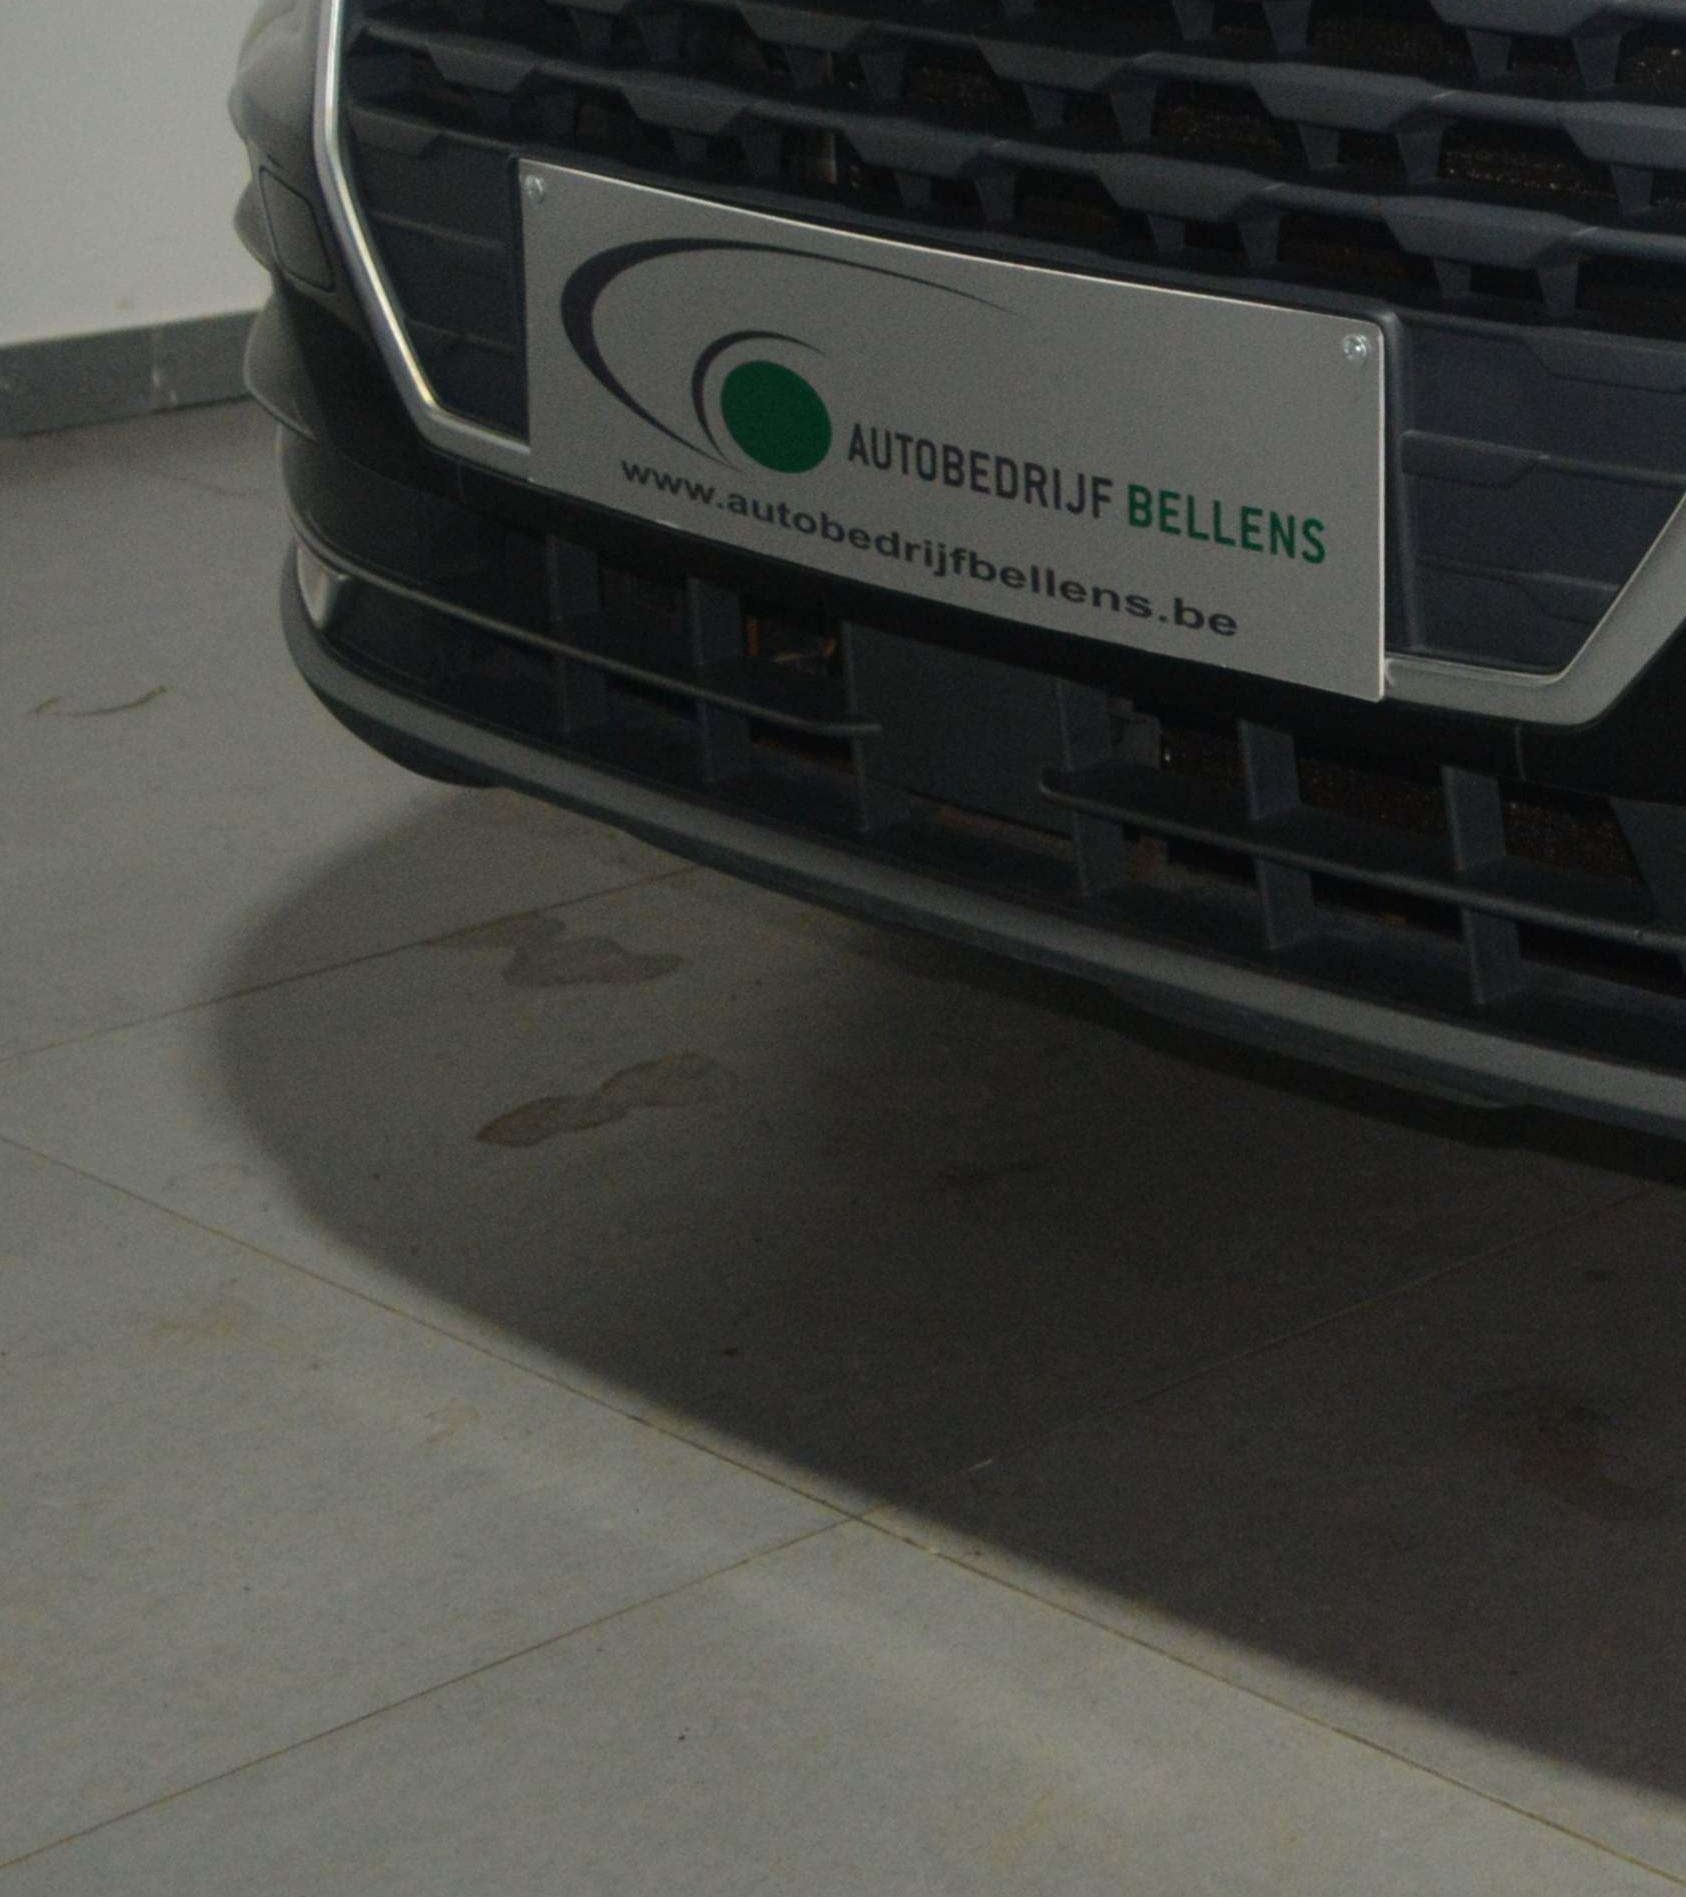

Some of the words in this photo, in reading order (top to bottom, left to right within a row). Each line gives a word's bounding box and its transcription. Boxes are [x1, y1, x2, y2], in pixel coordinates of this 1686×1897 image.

[621, 458, 1237, 638] www.autobedrijfbellens.be
[846, 421, 1113, 519] AUTOBEDRIJF
[1127, 483, 1327, 565] BELLENS
